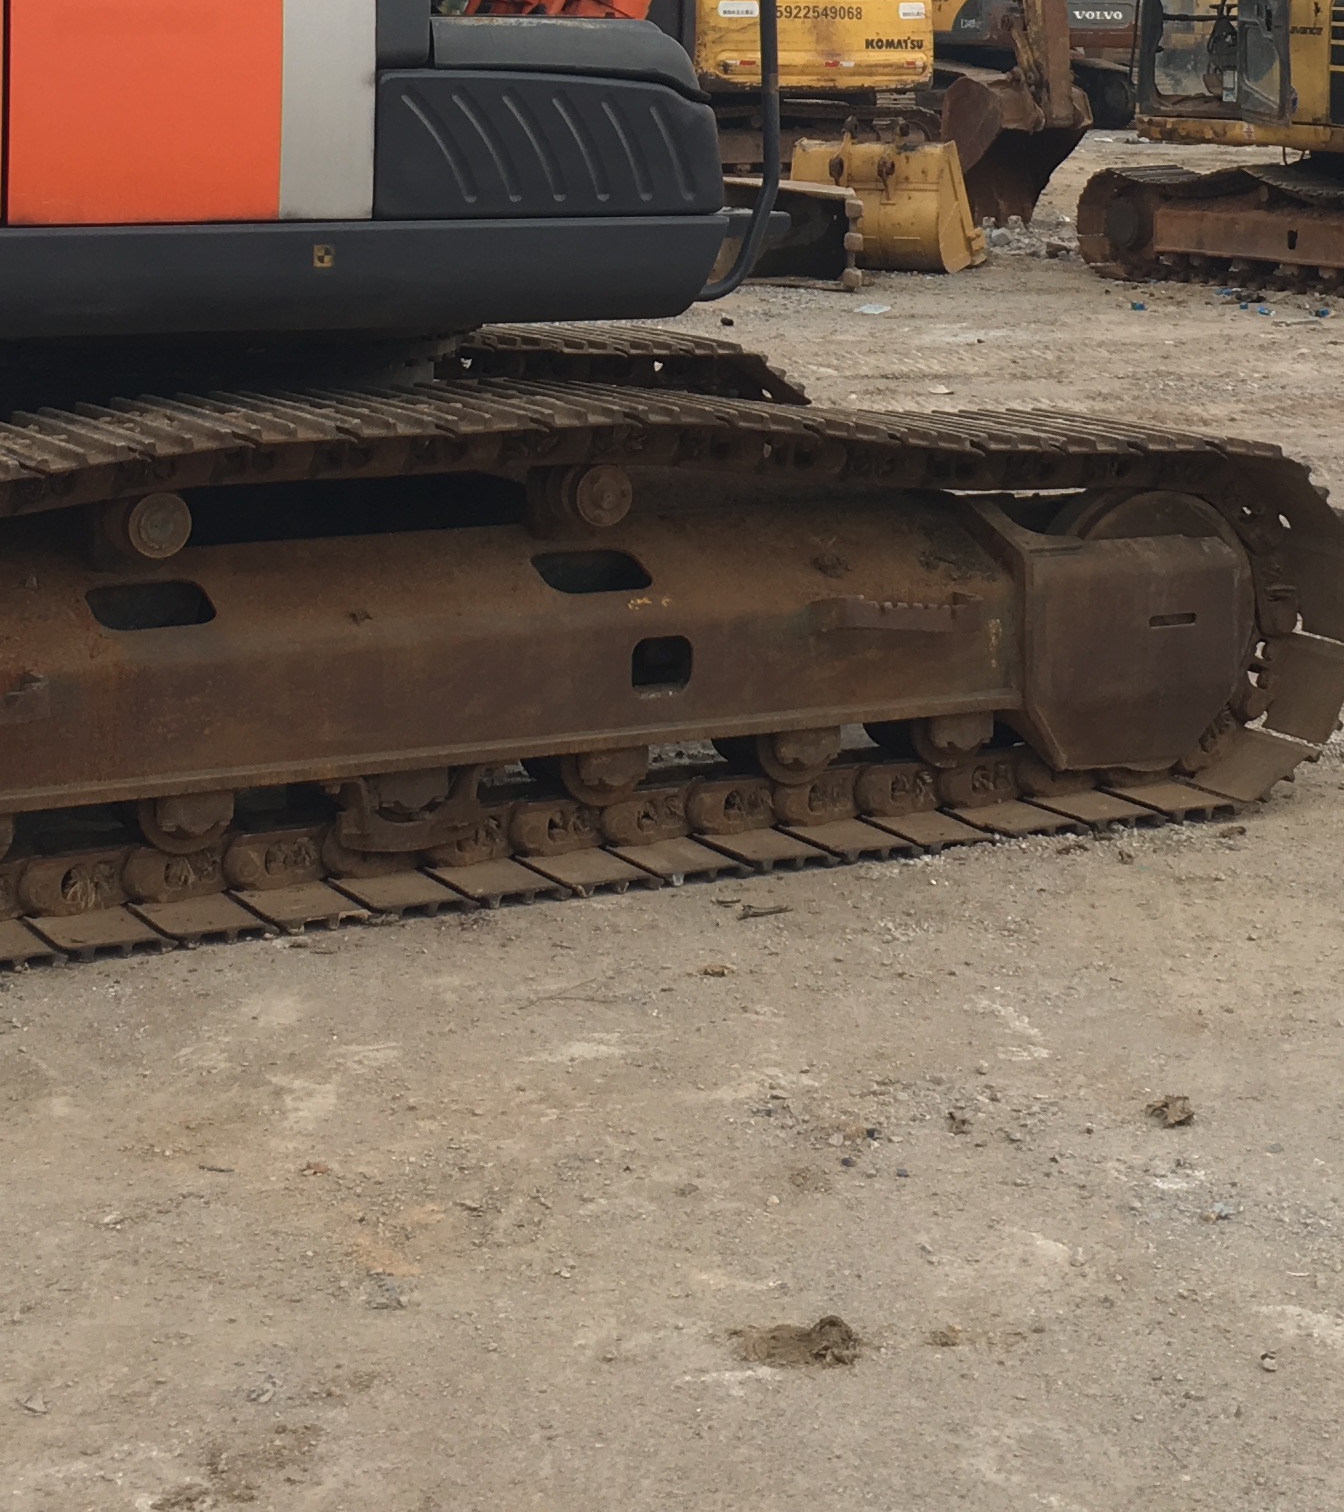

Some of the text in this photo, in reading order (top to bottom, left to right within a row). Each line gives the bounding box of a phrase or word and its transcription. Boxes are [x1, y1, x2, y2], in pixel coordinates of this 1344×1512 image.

[775, 4, 863, 20] 5922549068
[1073, 10, 1123, 20] VOLVO
[865, 37, 924, 50] KOMATSU
